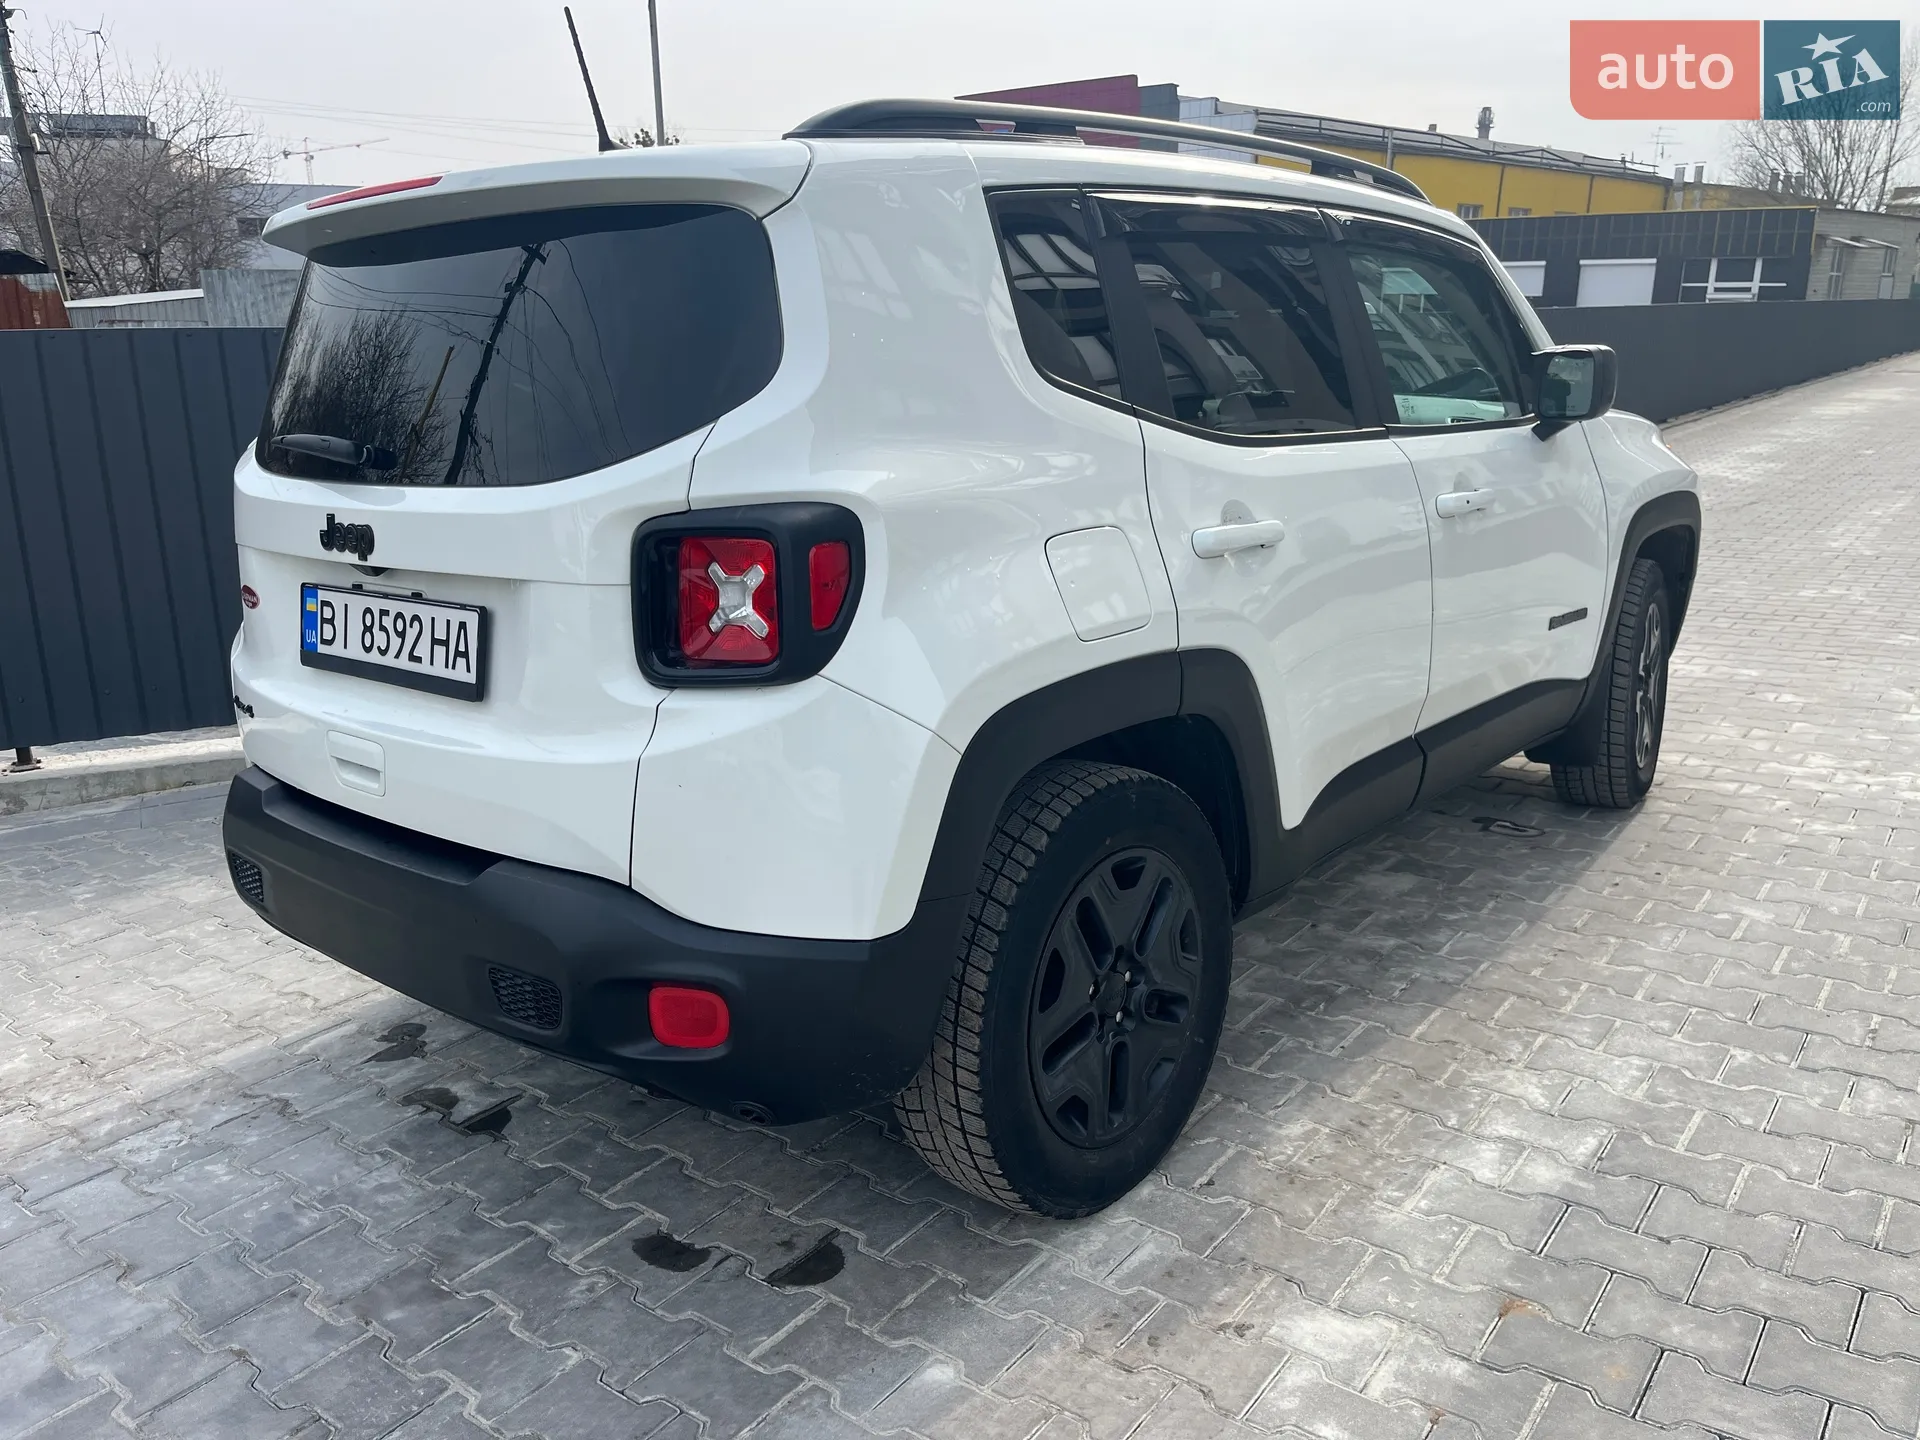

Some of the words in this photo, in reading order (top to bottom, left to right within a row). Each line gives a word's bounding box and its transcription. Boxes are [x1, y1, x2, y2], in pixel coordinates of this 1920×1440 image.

[319, 513, 375, 562] Jeep
[305, 629, 317, 644] UA
[320, 600, 349, 650] BI
